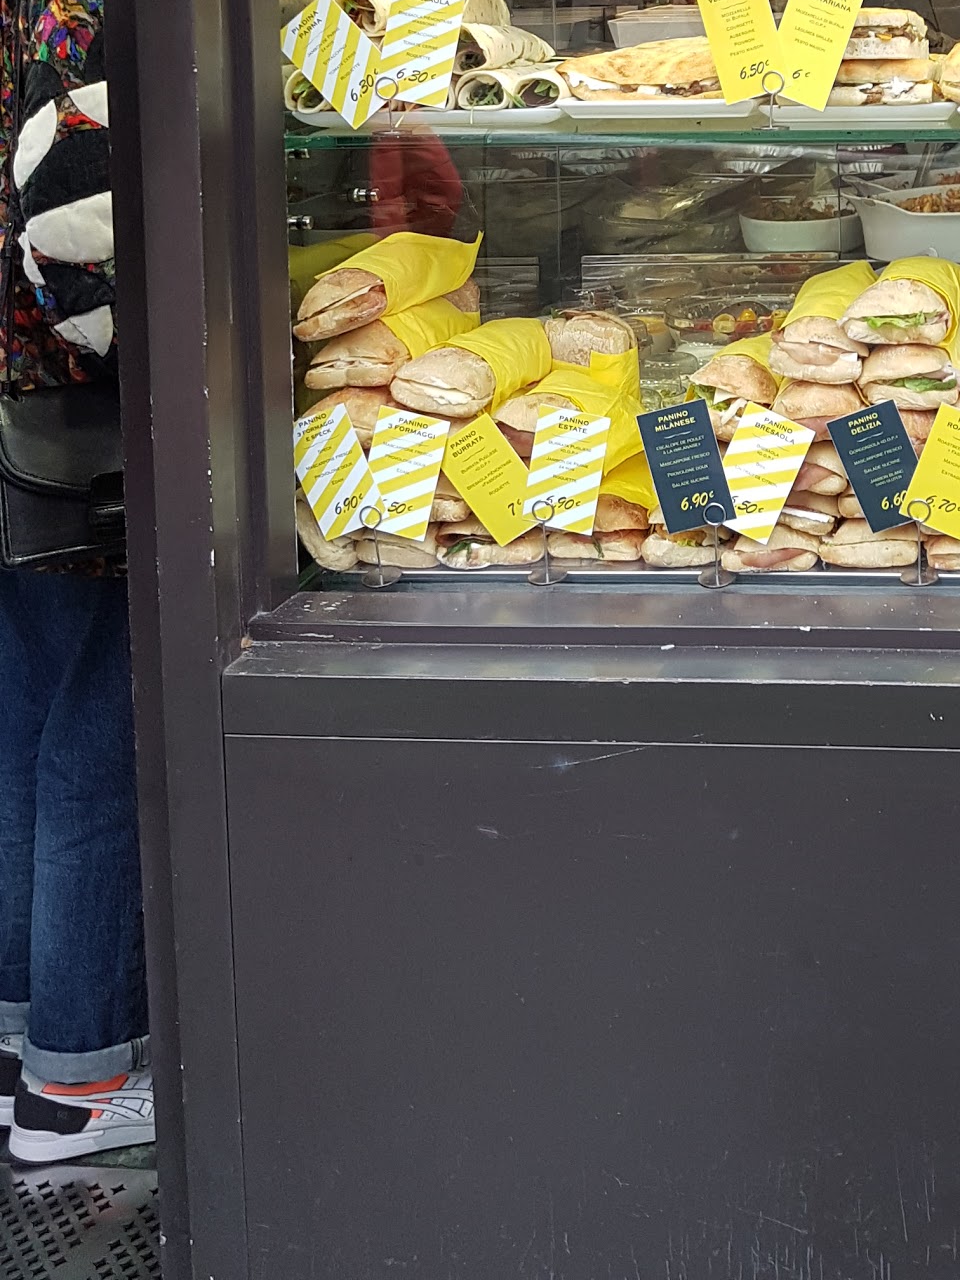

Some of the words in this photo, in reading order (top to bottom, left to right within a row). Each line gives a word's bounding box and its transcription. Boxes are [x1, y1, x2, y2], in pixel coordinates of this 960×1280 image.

[291, 10, 319, 35] PIADINA
[299, 18, 322, 39] PARMA
[298, 413, 327, 428] PANINO
[398, 417, 429, 429] PANINO
[559, 416, 589, 426] PANINO
[658, 410, 688, 423] PANINO
[848, 412, 878, 428] PANINO
[302, 419, 334, 435] FORMAGGI
[394, 425, 436, 439] FORMAGGI
[558, 423, 588, 434] ESTATE
[655, 417, 696, 432] MILANESE
[764, 417, 793, 434] PANINO
[851, 420, 881, 435] DELIZIA
[450, 430, 477, 450] PANINO
[755, 422, 795, 445] BRESAOLA
[452, 435, 484, 458] BURRATA
